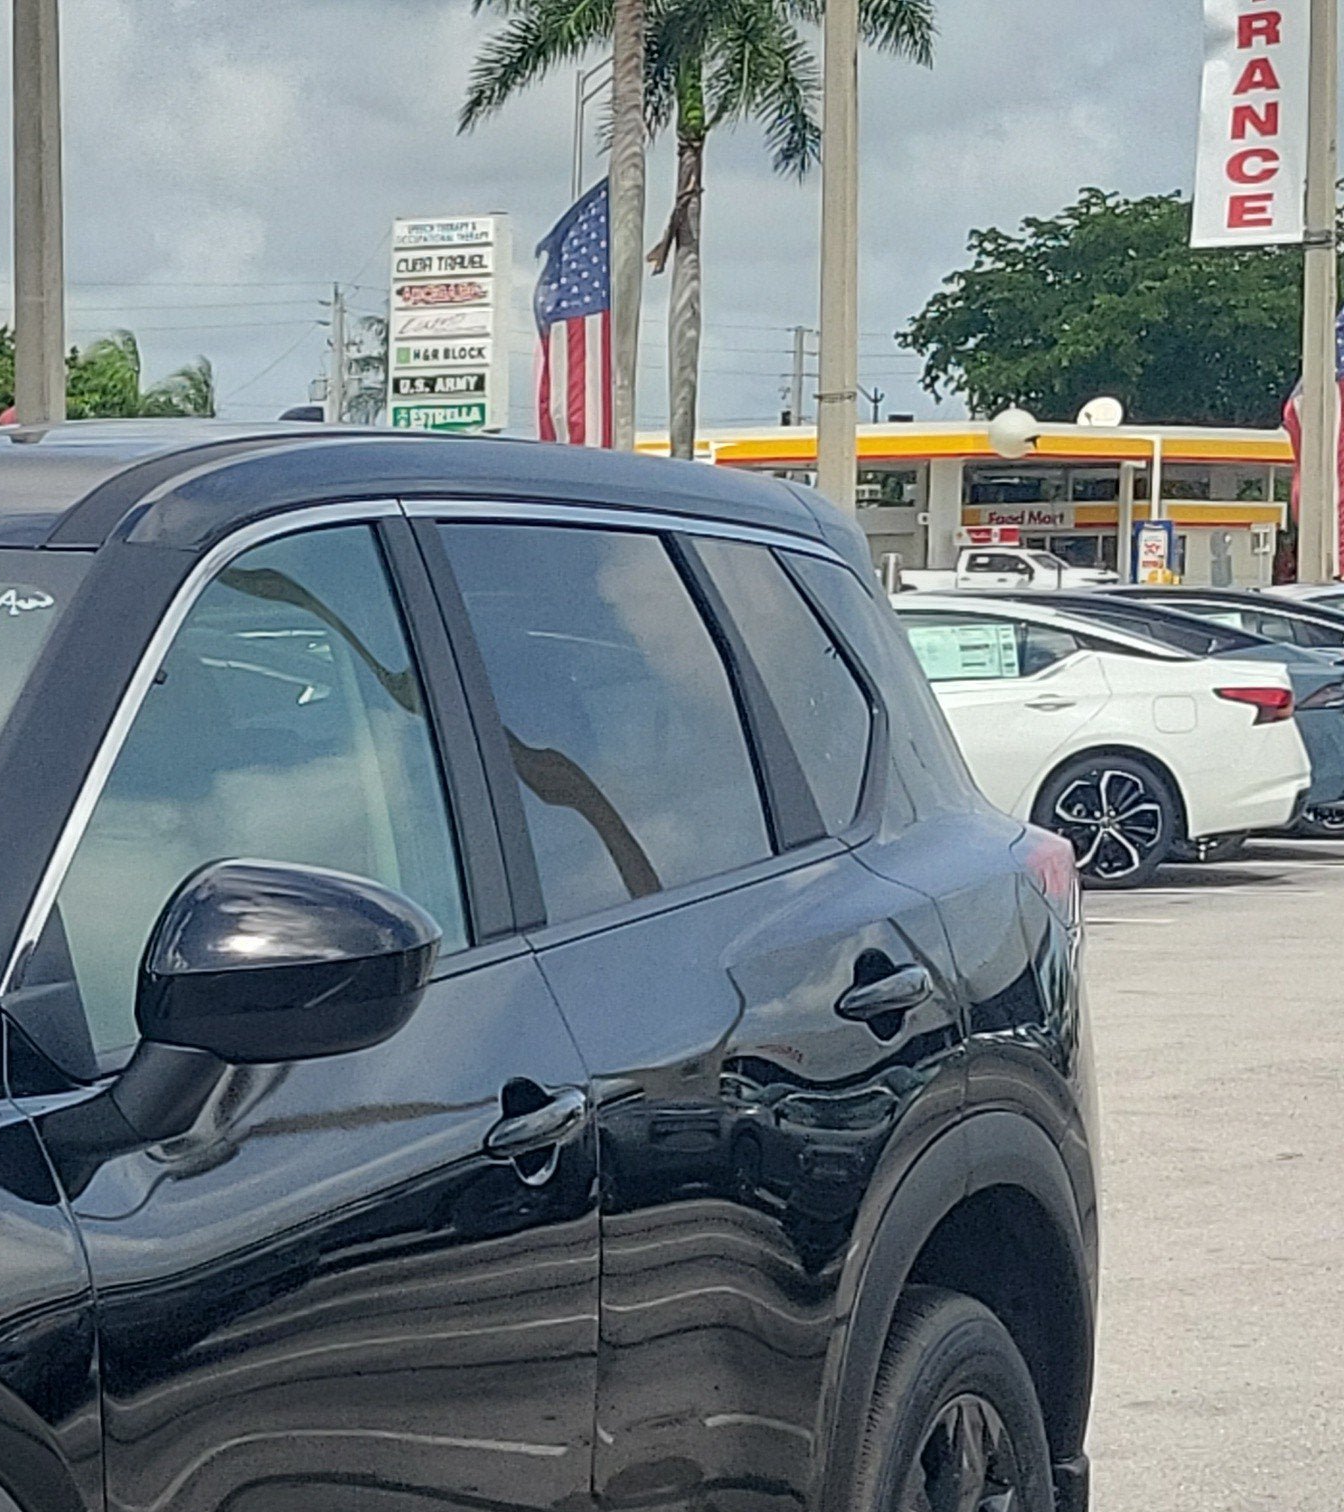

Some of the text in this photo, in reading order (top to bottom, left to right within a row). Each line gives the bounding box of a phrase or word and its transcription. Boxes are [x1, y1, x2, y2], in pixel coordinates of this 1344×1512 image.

[1226, 0, 1282, 228] RANCE
[396, 254, 488, 273] CUBA TRAVEL
[413, 347, 486, 361] H&R BLOCK
[399, 376, 478, 394] U.S. ARMY
[988, 509, 1064, 526] Food Mart
